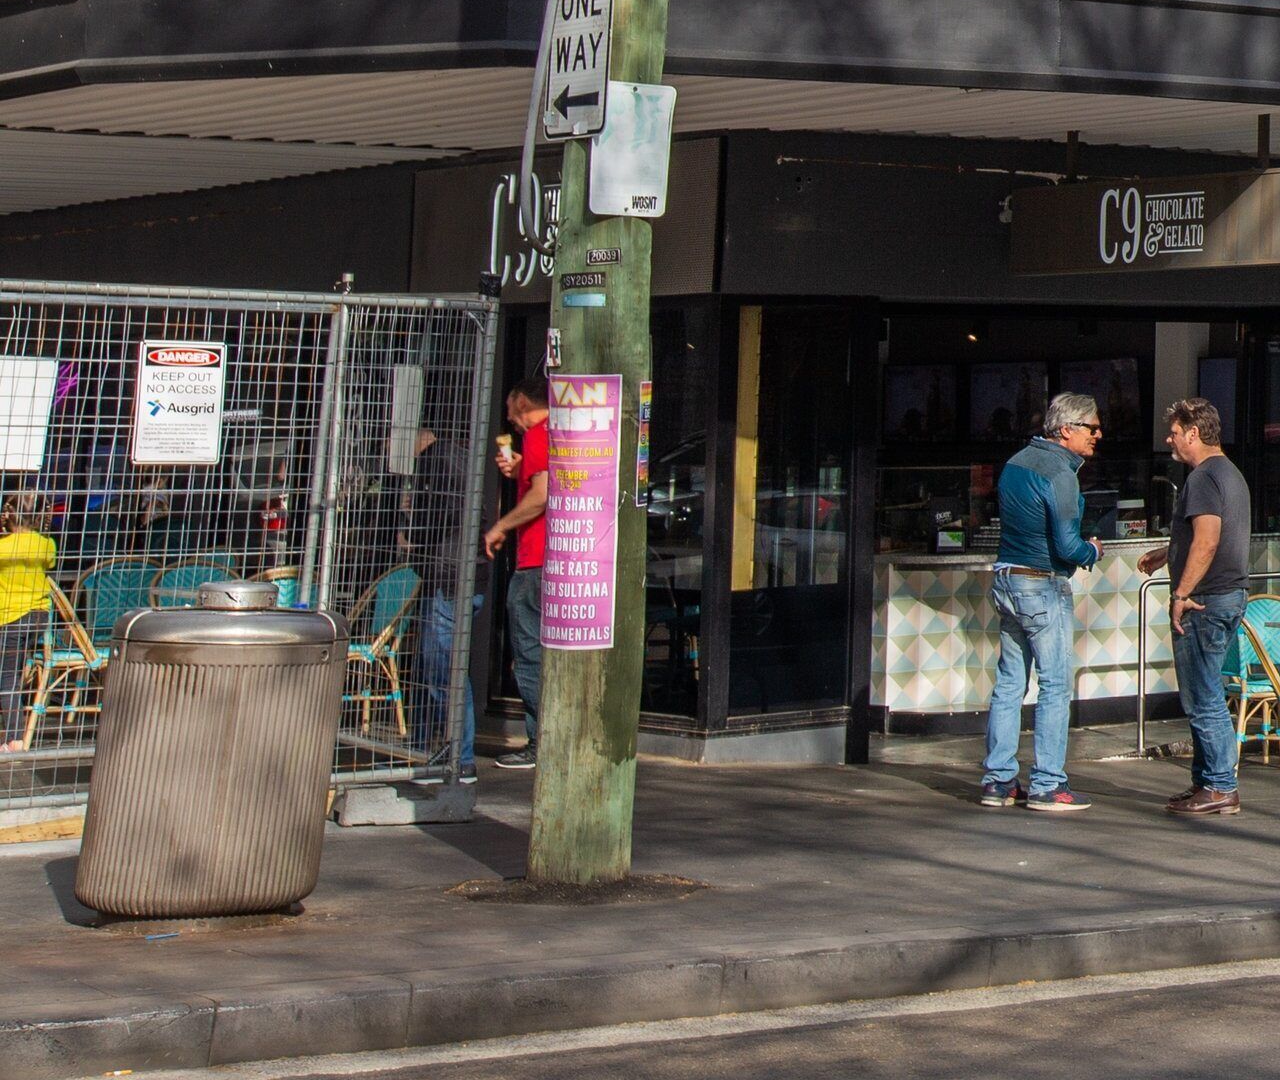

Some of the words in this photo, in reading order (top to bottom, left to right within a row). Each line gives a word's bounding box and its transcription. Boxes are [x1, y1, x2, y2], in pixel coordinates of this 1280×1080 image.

[556, 32, 603, 73] WAY
[1145, 197, 1205, 222] CHOCOLATE
[1099, 187, 1141, 264] C9
[1143, 222, 1164, 257] &
[1164, 224, 1204, 248] GELATO
[157, 351, 210, 363] DANGER
[152, 372, 185, 381] KEEP
[188, 372, 213, 382] OUT
[146, 384, 165, 394] NO
[167, 385, 217, 395] ACCESS
[552, 382, 608, 406] VAN
[166, 402, 215, 416] Ausgrid
[565, 496, 603, 512] SHARK
[551, 518, 594, 535] COSMO'S
[549, 537, 596, 552] MIDNIGHT
[568, 561, 599, 576] RATS
[558, 582, 609, 598] SULTANA
[545, 603, 559, 618] SAN
[561, 604, 596, 619] CISCO
